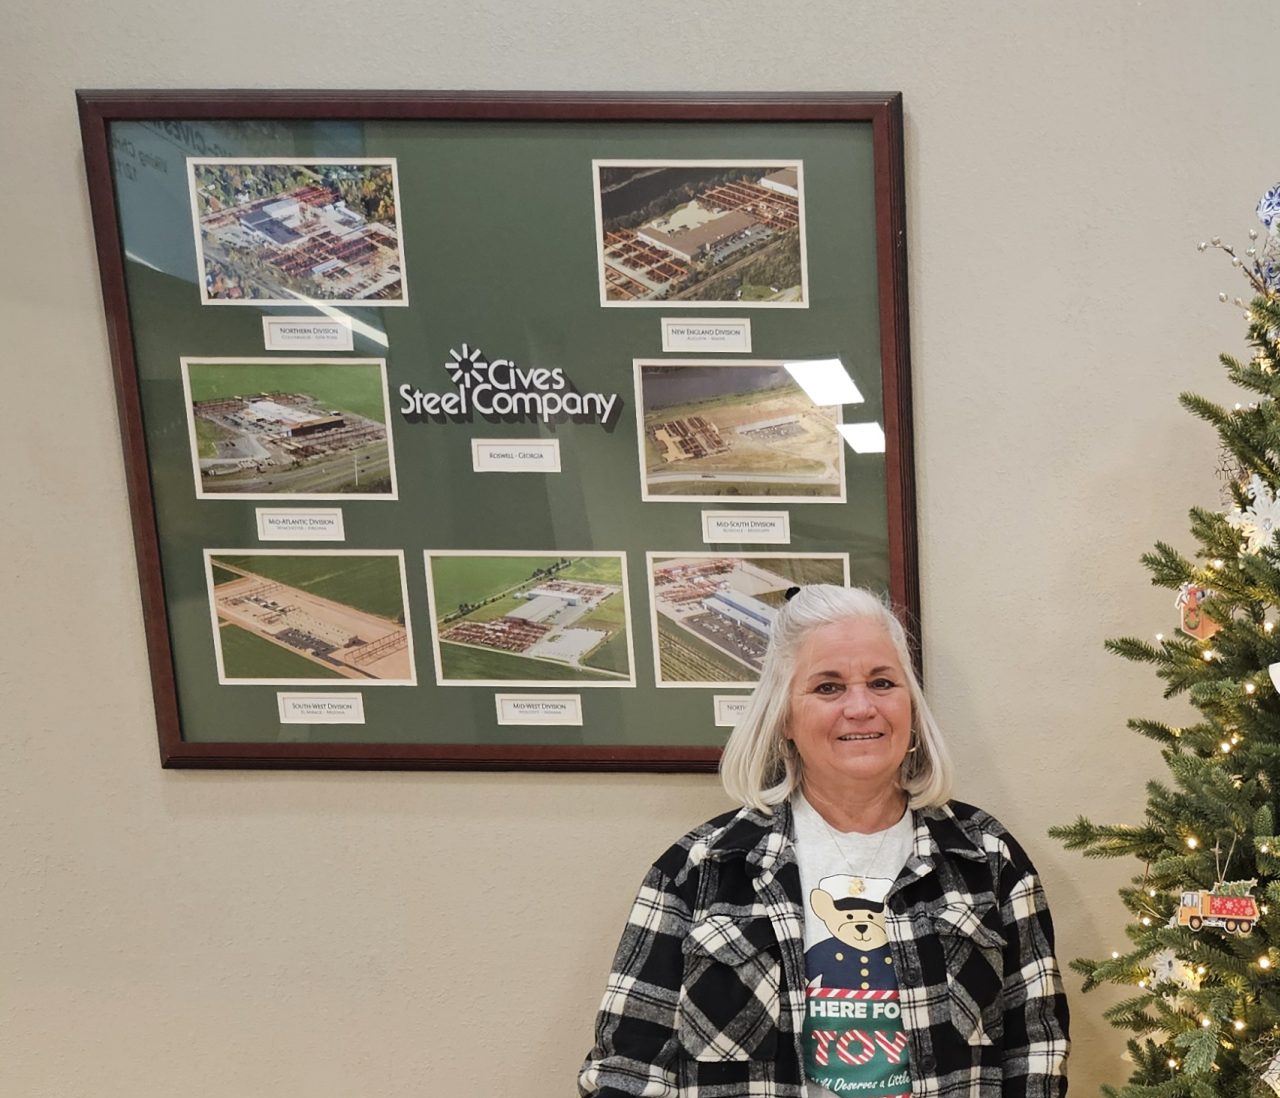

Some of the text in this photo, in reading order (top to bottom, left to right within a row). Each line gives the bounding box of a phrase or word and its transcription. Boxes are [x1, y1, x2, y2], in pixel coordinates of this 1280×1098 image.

[488, 360, 565, 390] Cives
[400, 383, 617, 423] Steel Company
[810, 1001, 900, 1019] HERE FO
[834, 1078, 877, 1092] Deserves
[888, 1071, 910, 1087] Little
